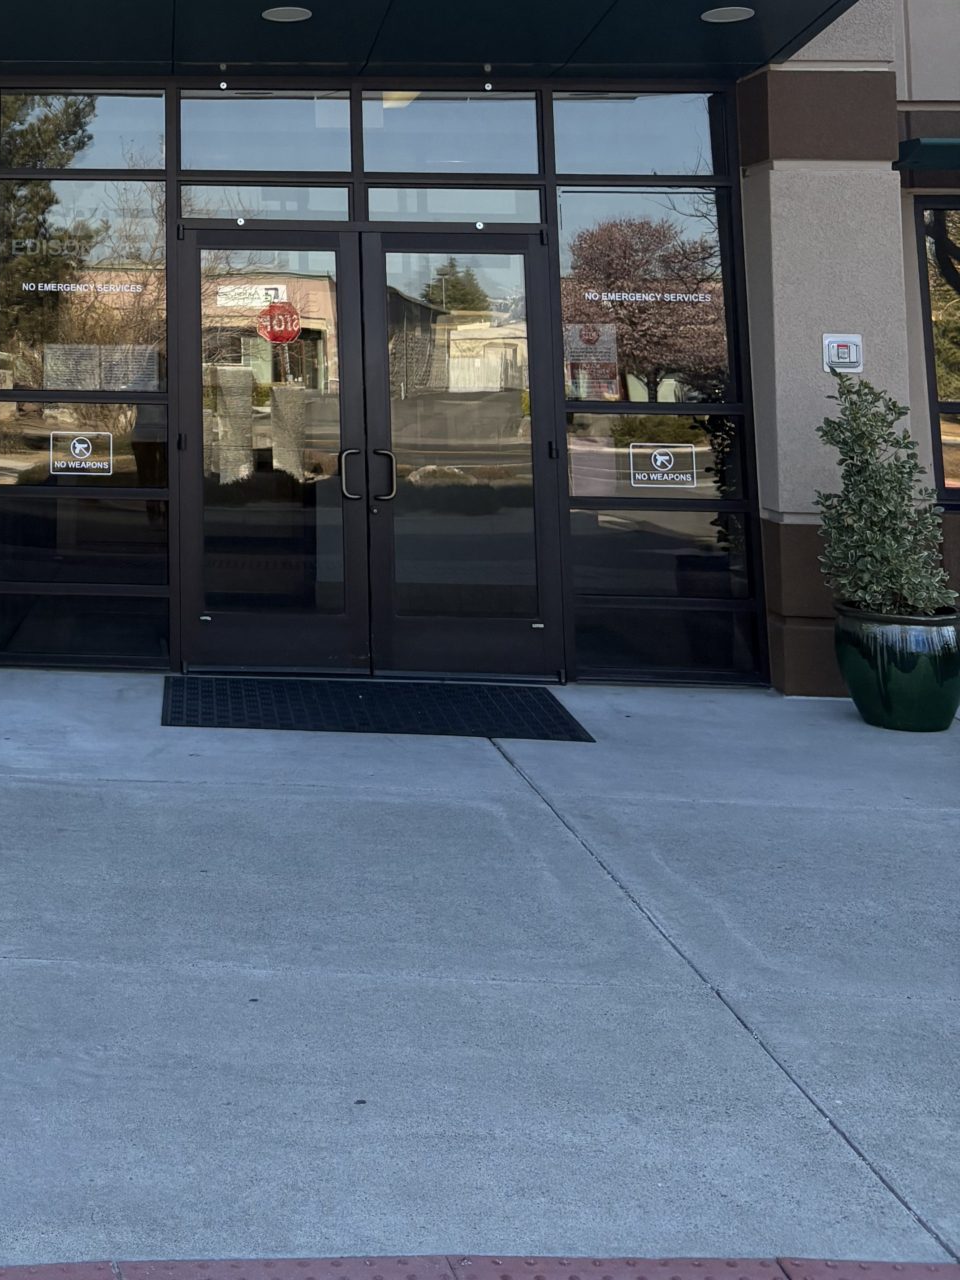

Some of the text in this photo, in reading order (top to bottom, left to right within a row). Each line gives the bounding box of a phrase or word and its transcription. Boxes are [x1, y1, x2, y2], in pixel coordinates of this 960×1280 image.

[22, 282, 143, 293] NO EMERGENCY SERVICES
[585, 292, 711, 302] NO EMERGENCY SERVICES
[54, 460, 109, 470] NO WEAPONS
[635, 472, 692, 482] NO WEAPONS
